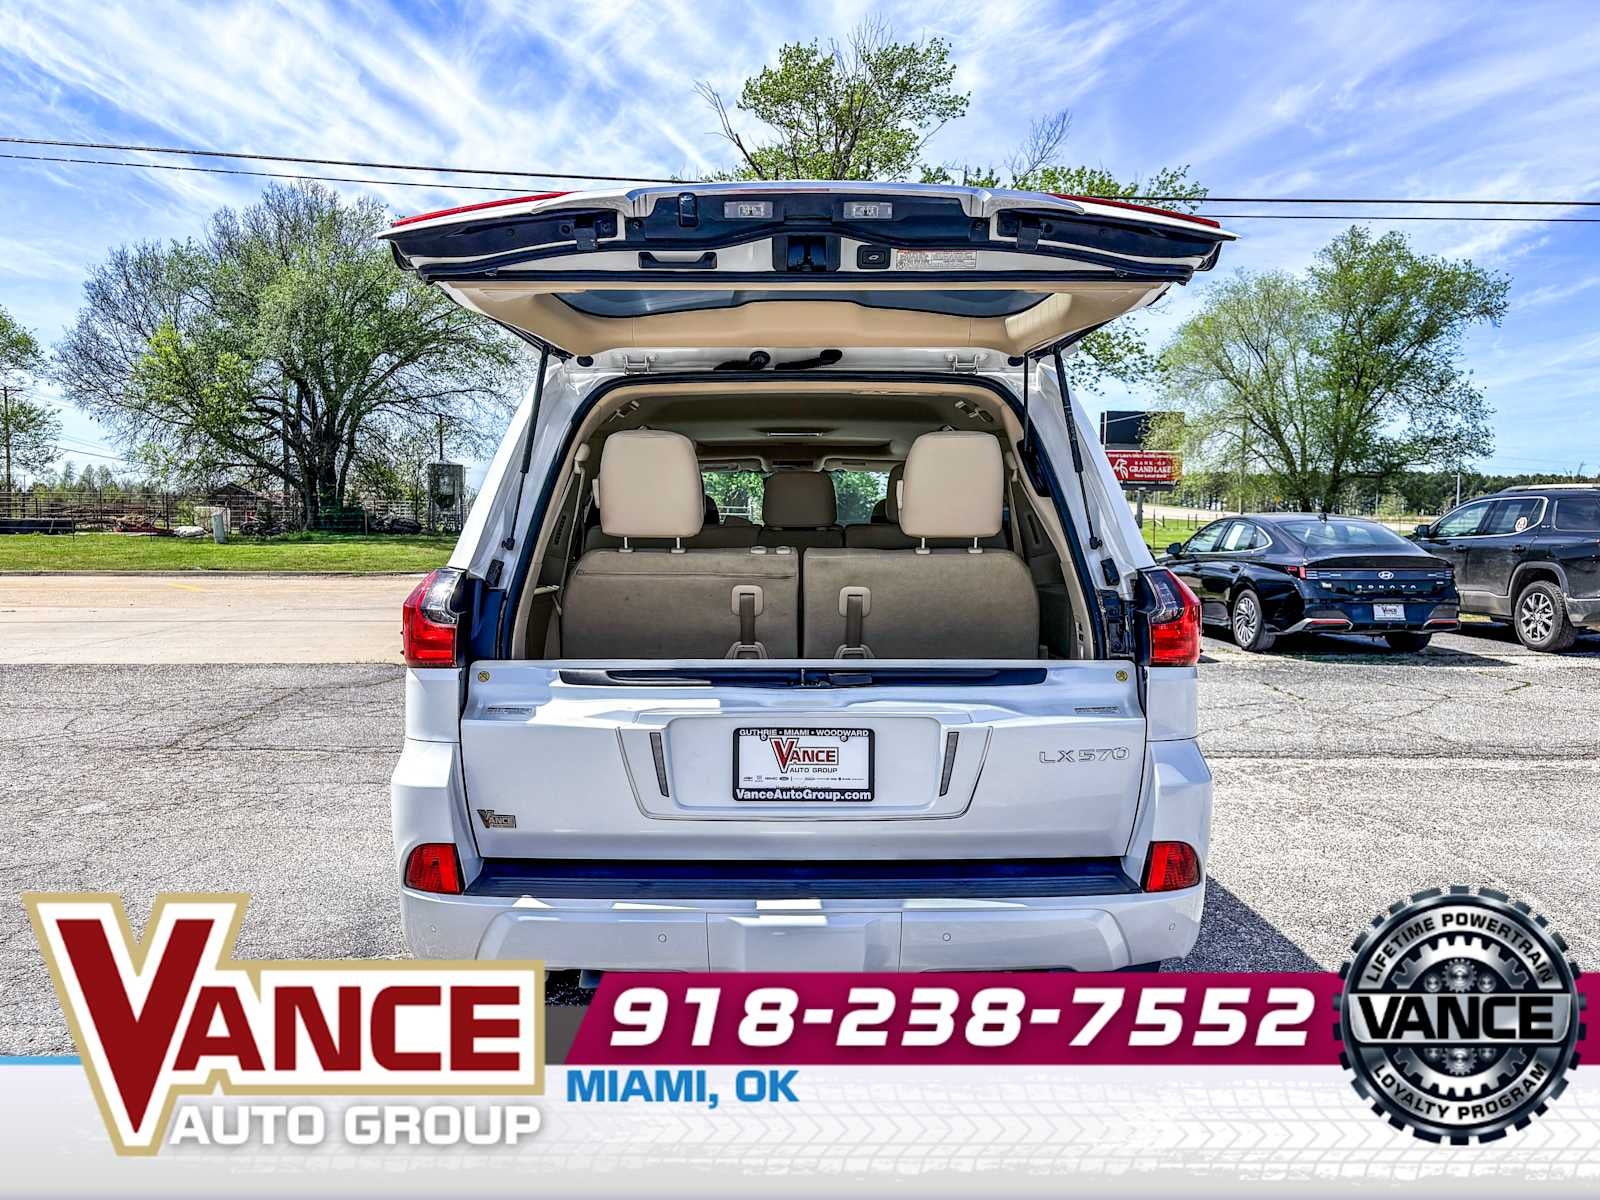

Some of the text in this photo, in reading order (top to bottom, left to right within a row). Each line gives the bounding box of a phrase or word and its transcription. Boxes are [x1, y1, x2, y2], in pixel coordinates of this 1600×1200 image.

[815, 729, 869, 737] WOODWARD
[771, 739, 837, 771] VANCE
[1039, 746, 1130, 763] LX 570
[735, 788, 872, 802] VanceAutoGroup.com
[477, 809, 514, 828] VANCE
